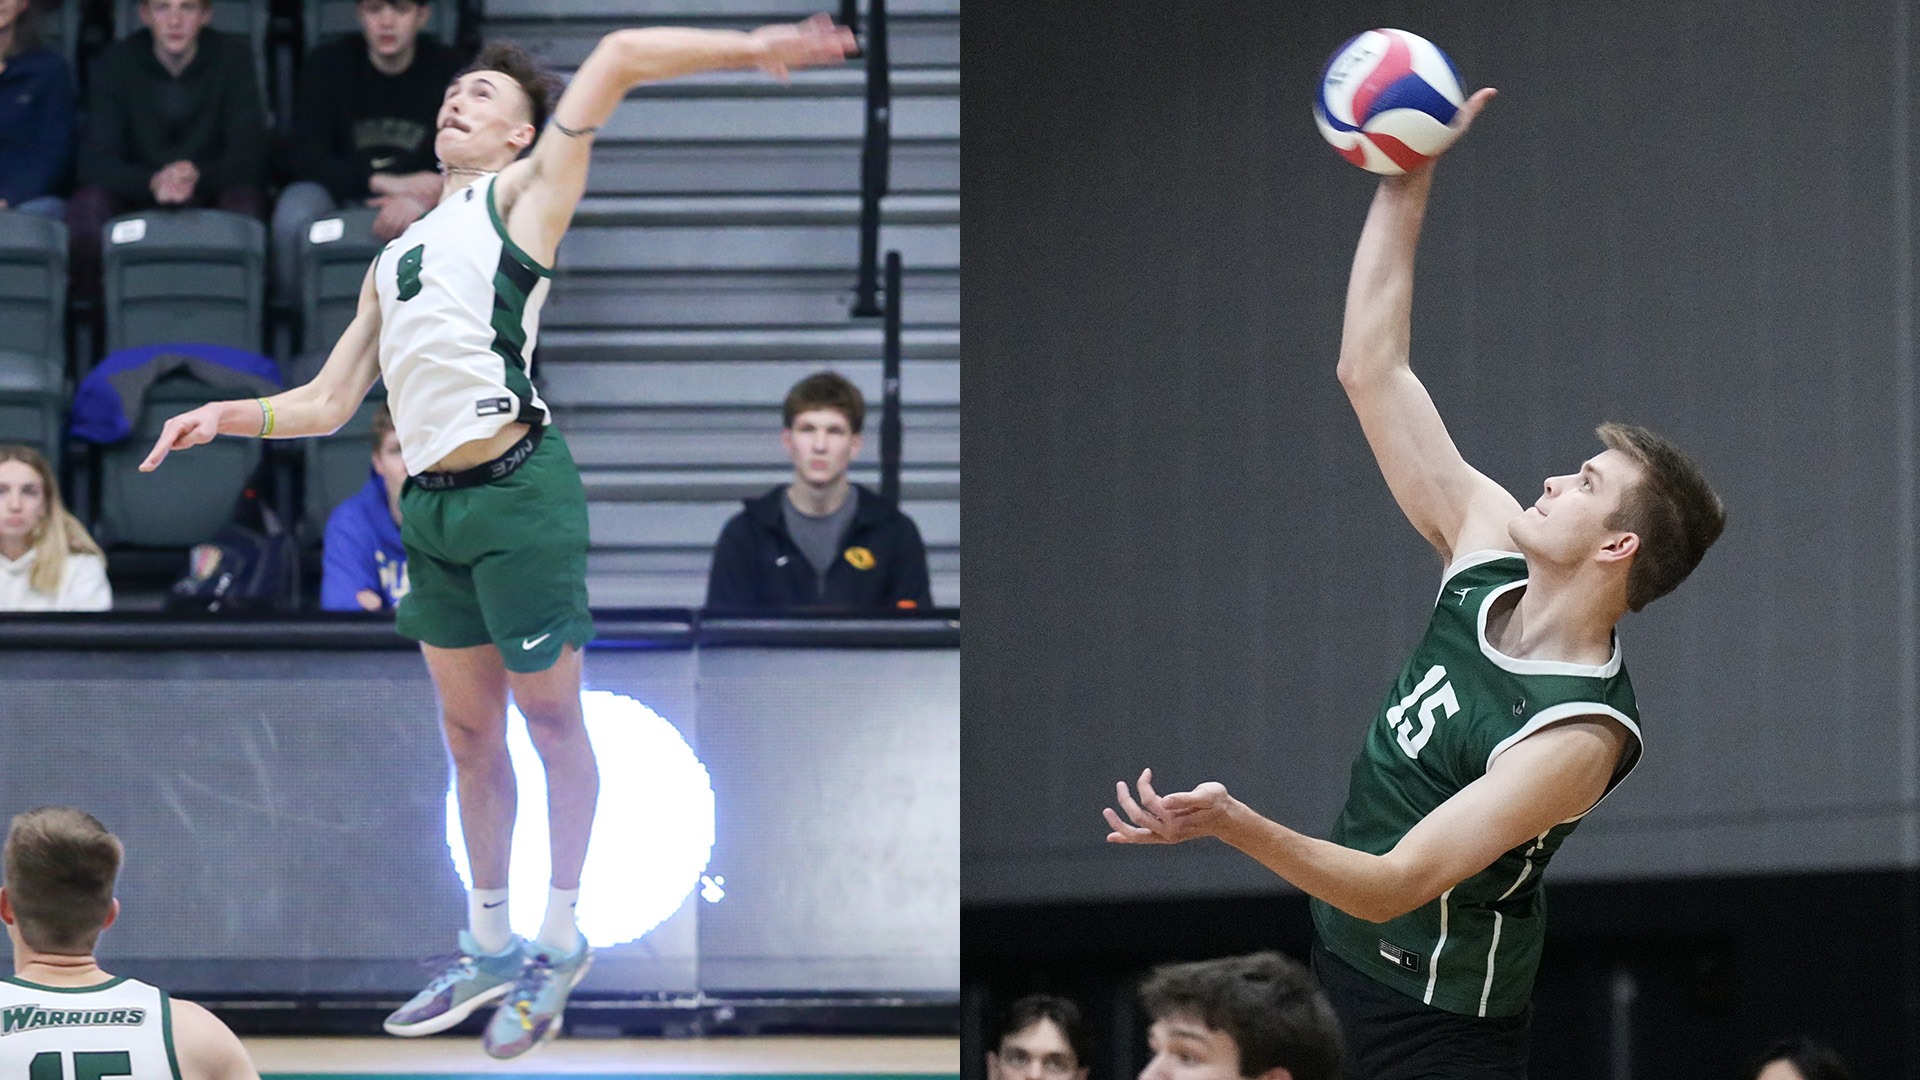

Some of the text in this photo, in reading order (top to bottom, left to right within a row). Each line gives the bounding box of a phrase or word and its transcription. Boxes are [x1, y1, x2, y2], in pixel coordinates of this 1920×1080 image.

[491, 439, 533, 478] NIKE
[1386, 665, 1460, 759] 15
[1, 1004, 146, 1035] WARRIORS
